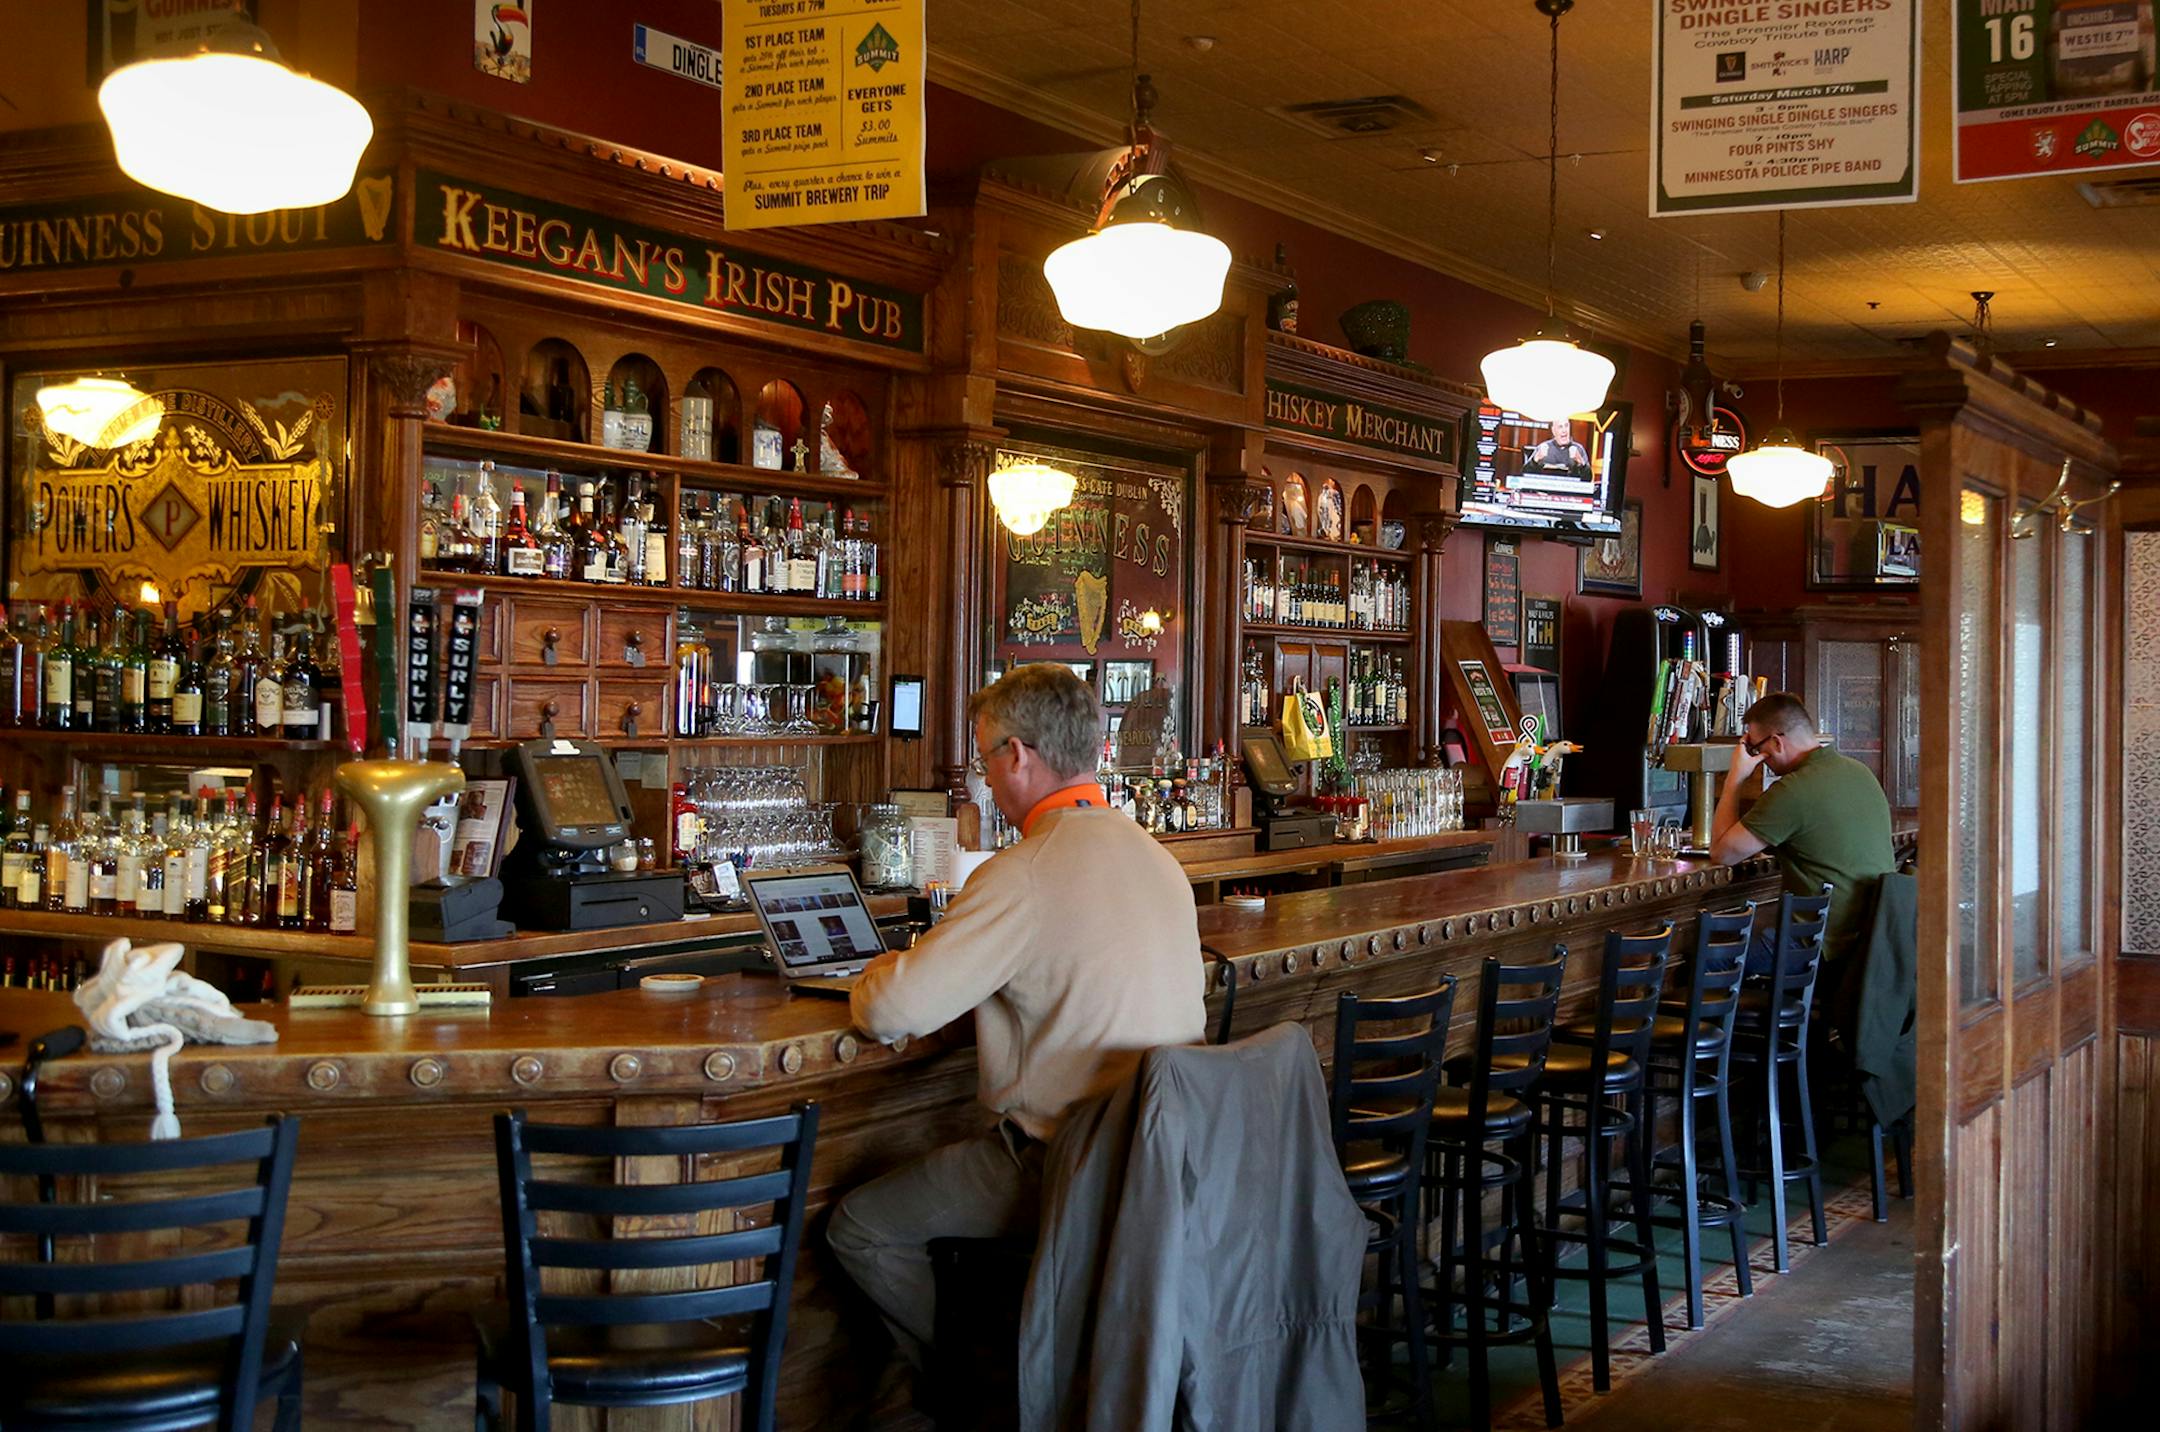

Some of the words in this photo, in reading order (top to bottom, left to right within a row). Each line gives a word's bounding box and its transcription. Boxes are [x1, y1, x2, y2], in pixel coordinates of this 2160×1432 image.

[759, 4, 796, 18] TUESDAYS
[797, 2, 806, 13] AT
[808, 0, 826, 12] 7PM
[1680, 6, 1770, 30] DINGLE
[1777, 0, 1892, 19] SINGERS
[1736, 23, 1799, 36] Premier
[1805, 16, 1874, 30] Reverse
[745, 36, 762, 49] 1ST
[765, 32, 794, 47] PLACE
[799, 28, 825, 43] TEAM
[1694, 36, 1758, 49] Cowboy
[1762, 30, 1819, 42] Tribute
[1984, 14, 2035, 63] 16
[2065, 31, 2112, 47] WESTIE
[673, 44, 722, 85] DINGLE
[855, 50, 899, 66] SUMMIT
[1814, 48, 1850, 66] HARP
[1984, 70, 2032, 84] SPECIAL
[1985, 80, 2033, 93] TAPPING
[744, 85, 763, 98] 2ND
[766, 82, 794, 96] PLACE
[798, 78, 824, 93] TEAM
[848, 84, 906, 100] EVERYONE
[1711, 89, 1773, 105] Saturday
[1776, 86, 1822, 99] March
[1825, 83, 1855, 95] 17th
[862, 100, 892, 114] GETS
[1987, 94, 2000, 104] AT
[2000, 109, 2024, 119] COME
[2027, 106, 2055, 117] ENJOY
[2065, 102, 2101, 114] SUMMIT
[2104, 97, 2140, 108] BARREL
[861, 119, 891, 133] $3.00
[1671, 117, 1736, 133] SWINGING
[1740, 114, 1785, 128] SINGLE
[1787, 109, 1835, 123] DINGLE
[1839, 103, 1898, 118] SINGERS
[742, 129, 760, 143] 3RD
[763, 126, 791, 141] PLACE
[795, 123, 822, 139] TEAM
[855, 133, 898, 147] Summits
[764, 143, 792, 154] Summit
[1729, 145, 1763, 157] FOUR
[1766, 141, 1804, 154] PINTS
[1808, 138, 1835, 150] SHY
[2075, 140, 2118, 154] SUMMIT
[768, 178, 790, 190] every
[793, 176, 824, 188] quarter
[865, 171, 873, 180] to
[1685, 168, 1759, 184] MINNESOTA
[1762, 164, 1808, 178] POLICE
[1811, 162, 1841, 175] PIPE
[1846, 159, 1882, 172] BAND
[755, 191, 801, 210] SUMMIT
[806, 186, 859, 206] BREWERY
[864, 184, 890, 200] TRIP
[191, 203, 329, 251] STOUT
[438, 185, 687, 293] KEEGAN'S
[703, 249, 816, 321] IRISH
[826, 278, 903, 340] PUB
[181, 393, 261, 459] DISTILLERY
[1345, 402, 1445, 455] MERCHANT
[1089, 478, 1113, 496] CAFE
[1116, 483, 1149, 500] DUBLIN
[39, 480, 135, 556] POWER'S
[164, 503, 182, 537] P
[208, 479, 313, 552] WHISKEY
[411, 638, 429, 715] SURLY
[448, 638, 472, 716] SURLY
